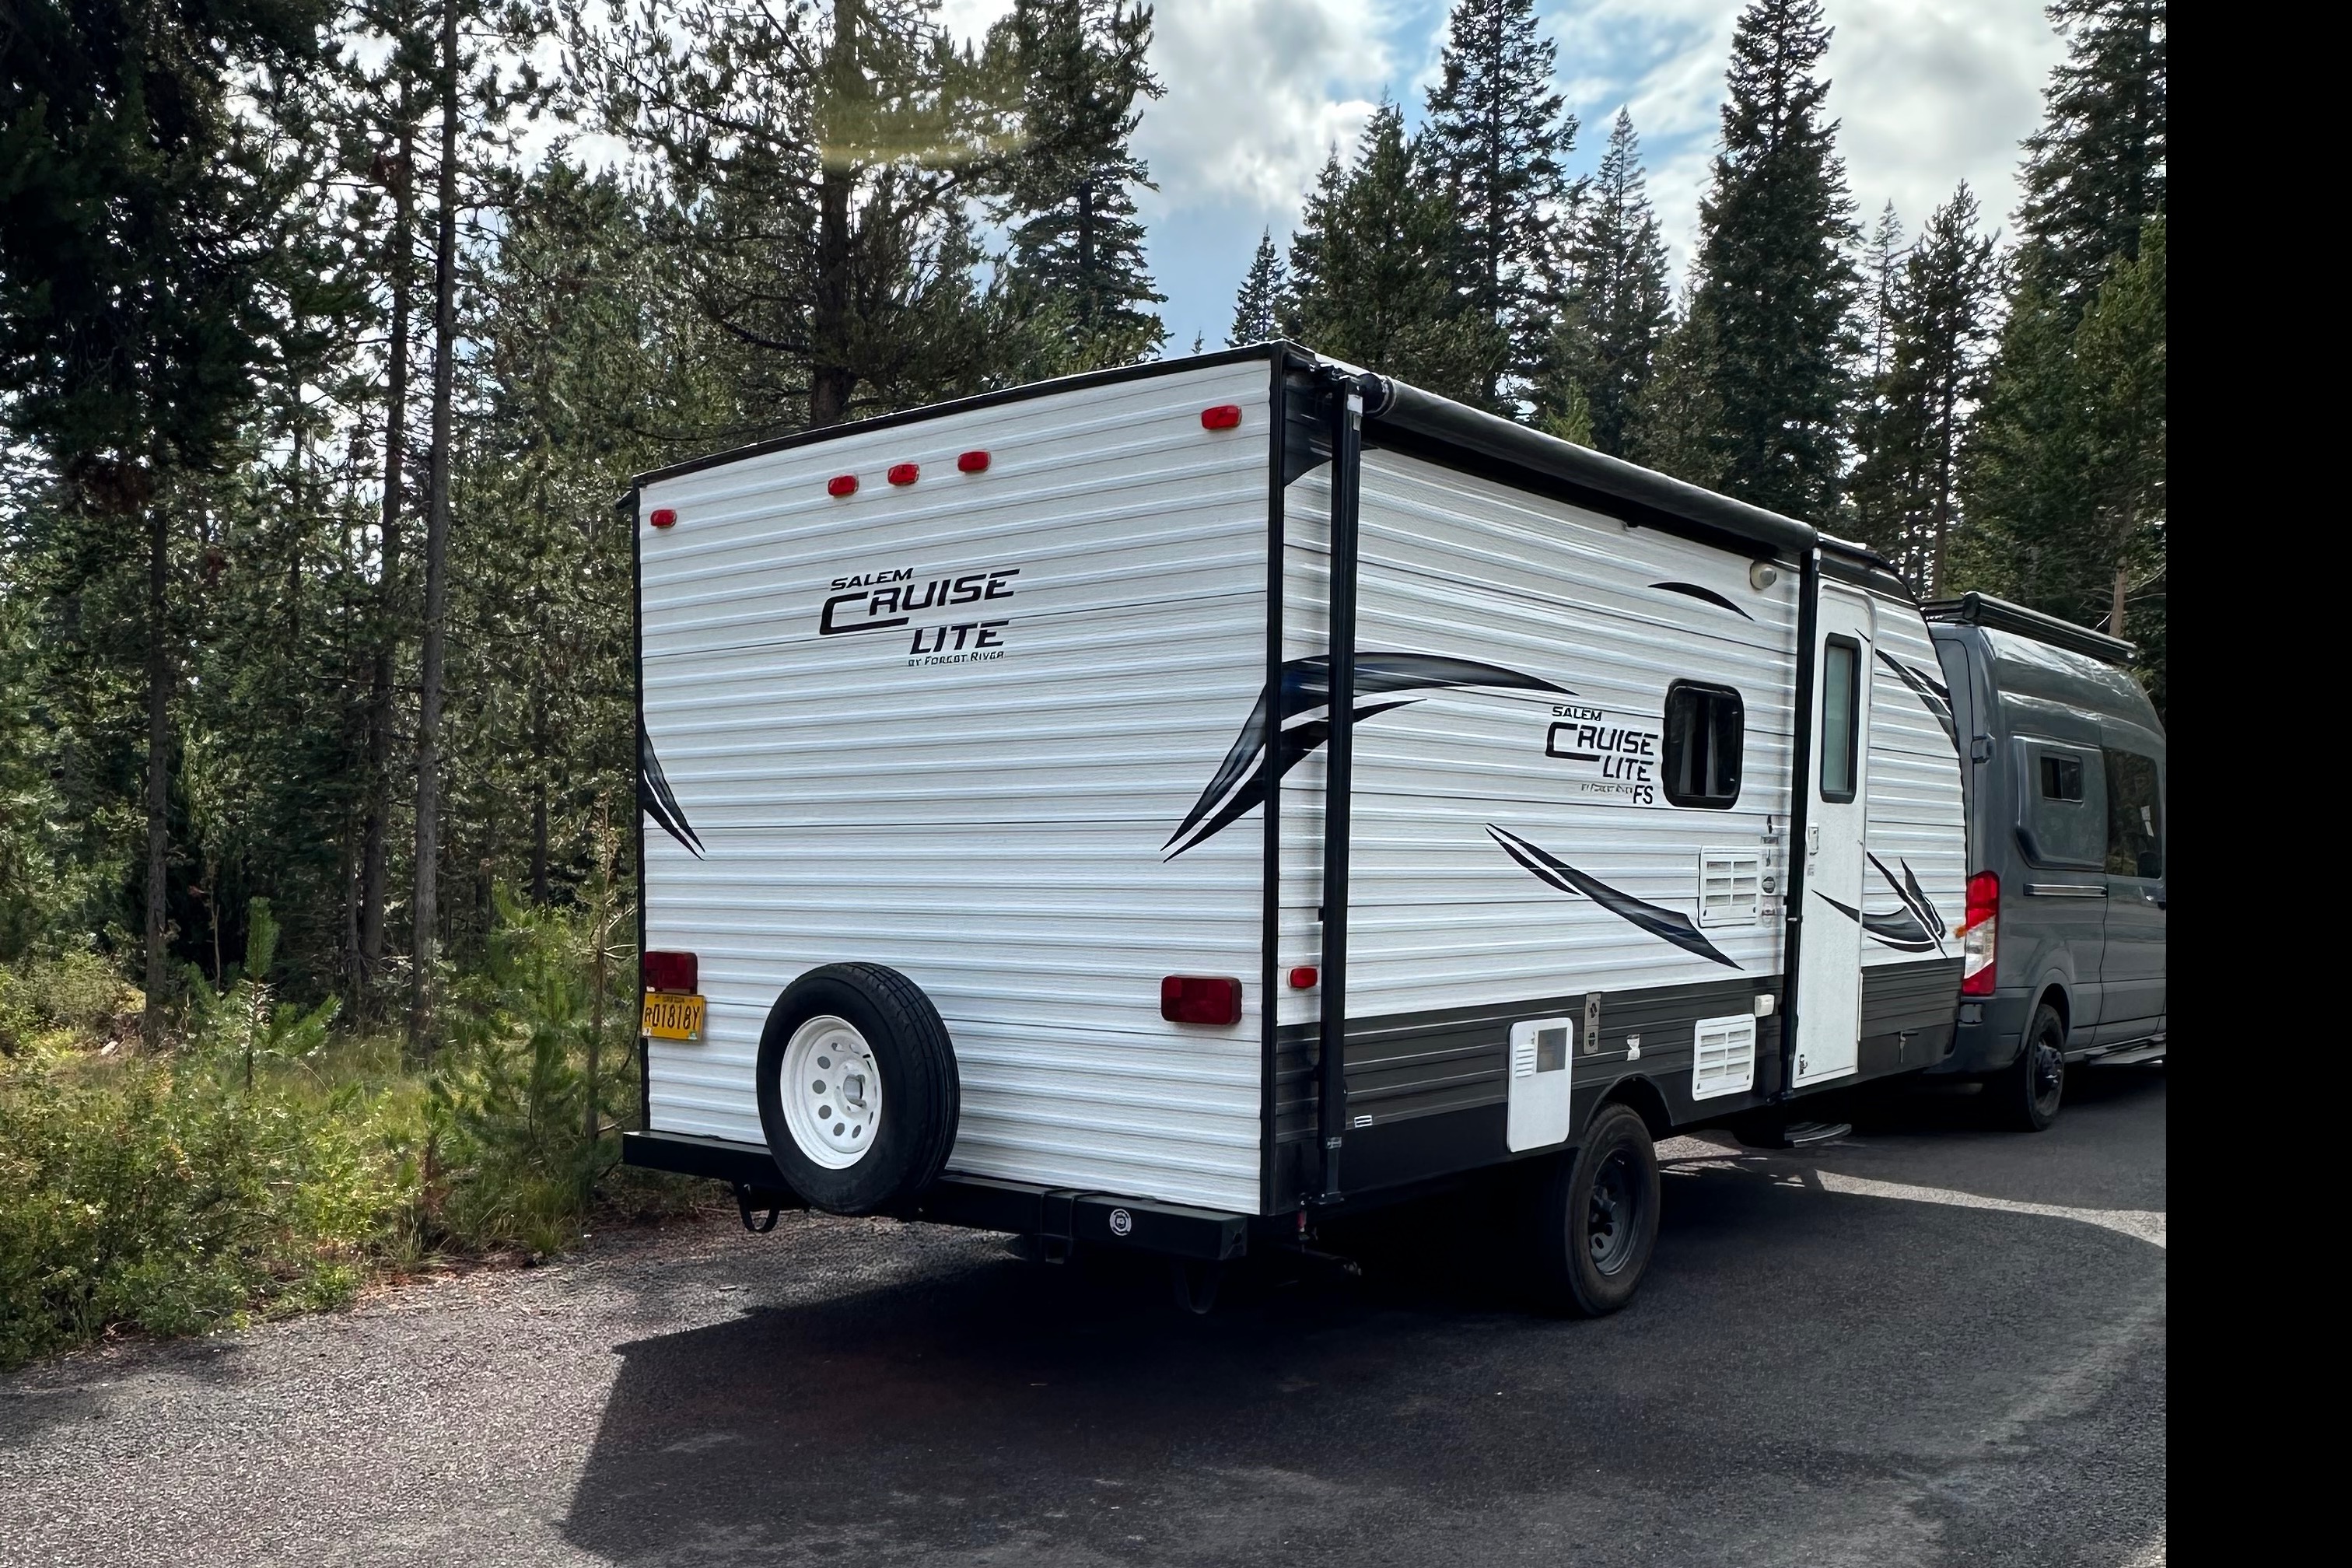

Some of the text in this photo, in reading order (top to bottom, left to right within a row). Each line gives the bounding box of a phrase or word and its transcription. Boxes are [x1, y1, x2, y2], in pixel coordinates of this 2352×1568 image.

[830, 568, 914, 591] SALEM
[819, 569, 1020, 635] CRUISE
[909, 621, 1010, 655] LITE
[1552, 706, 1603, 722] SALEM
[1545, 721, 1658, 762] CRUISE
[1602, 755, 1654, 782] LITE
[1633, 785, 1654, 804] FS
